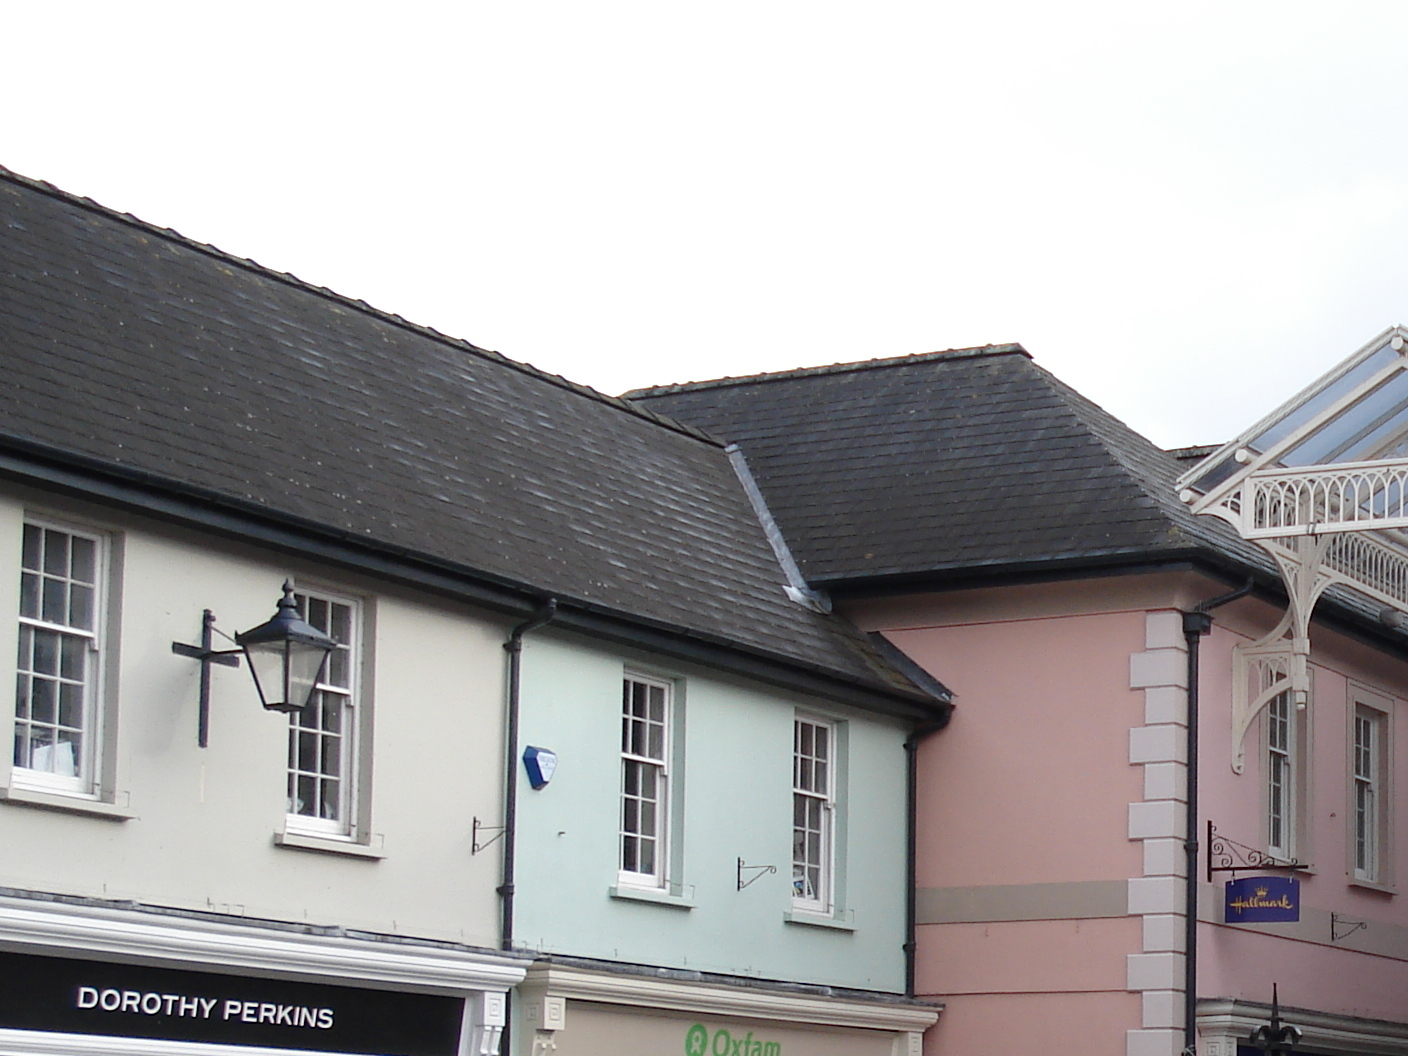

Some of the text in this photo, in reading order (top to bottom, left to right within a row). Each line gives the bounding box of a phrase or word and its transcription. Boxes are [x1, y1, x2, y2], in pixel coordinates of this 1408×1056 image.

[1230, 894, 1293, 915] Hallmark
[77, 985, 335, 1029] DOROTHY PERKINS
